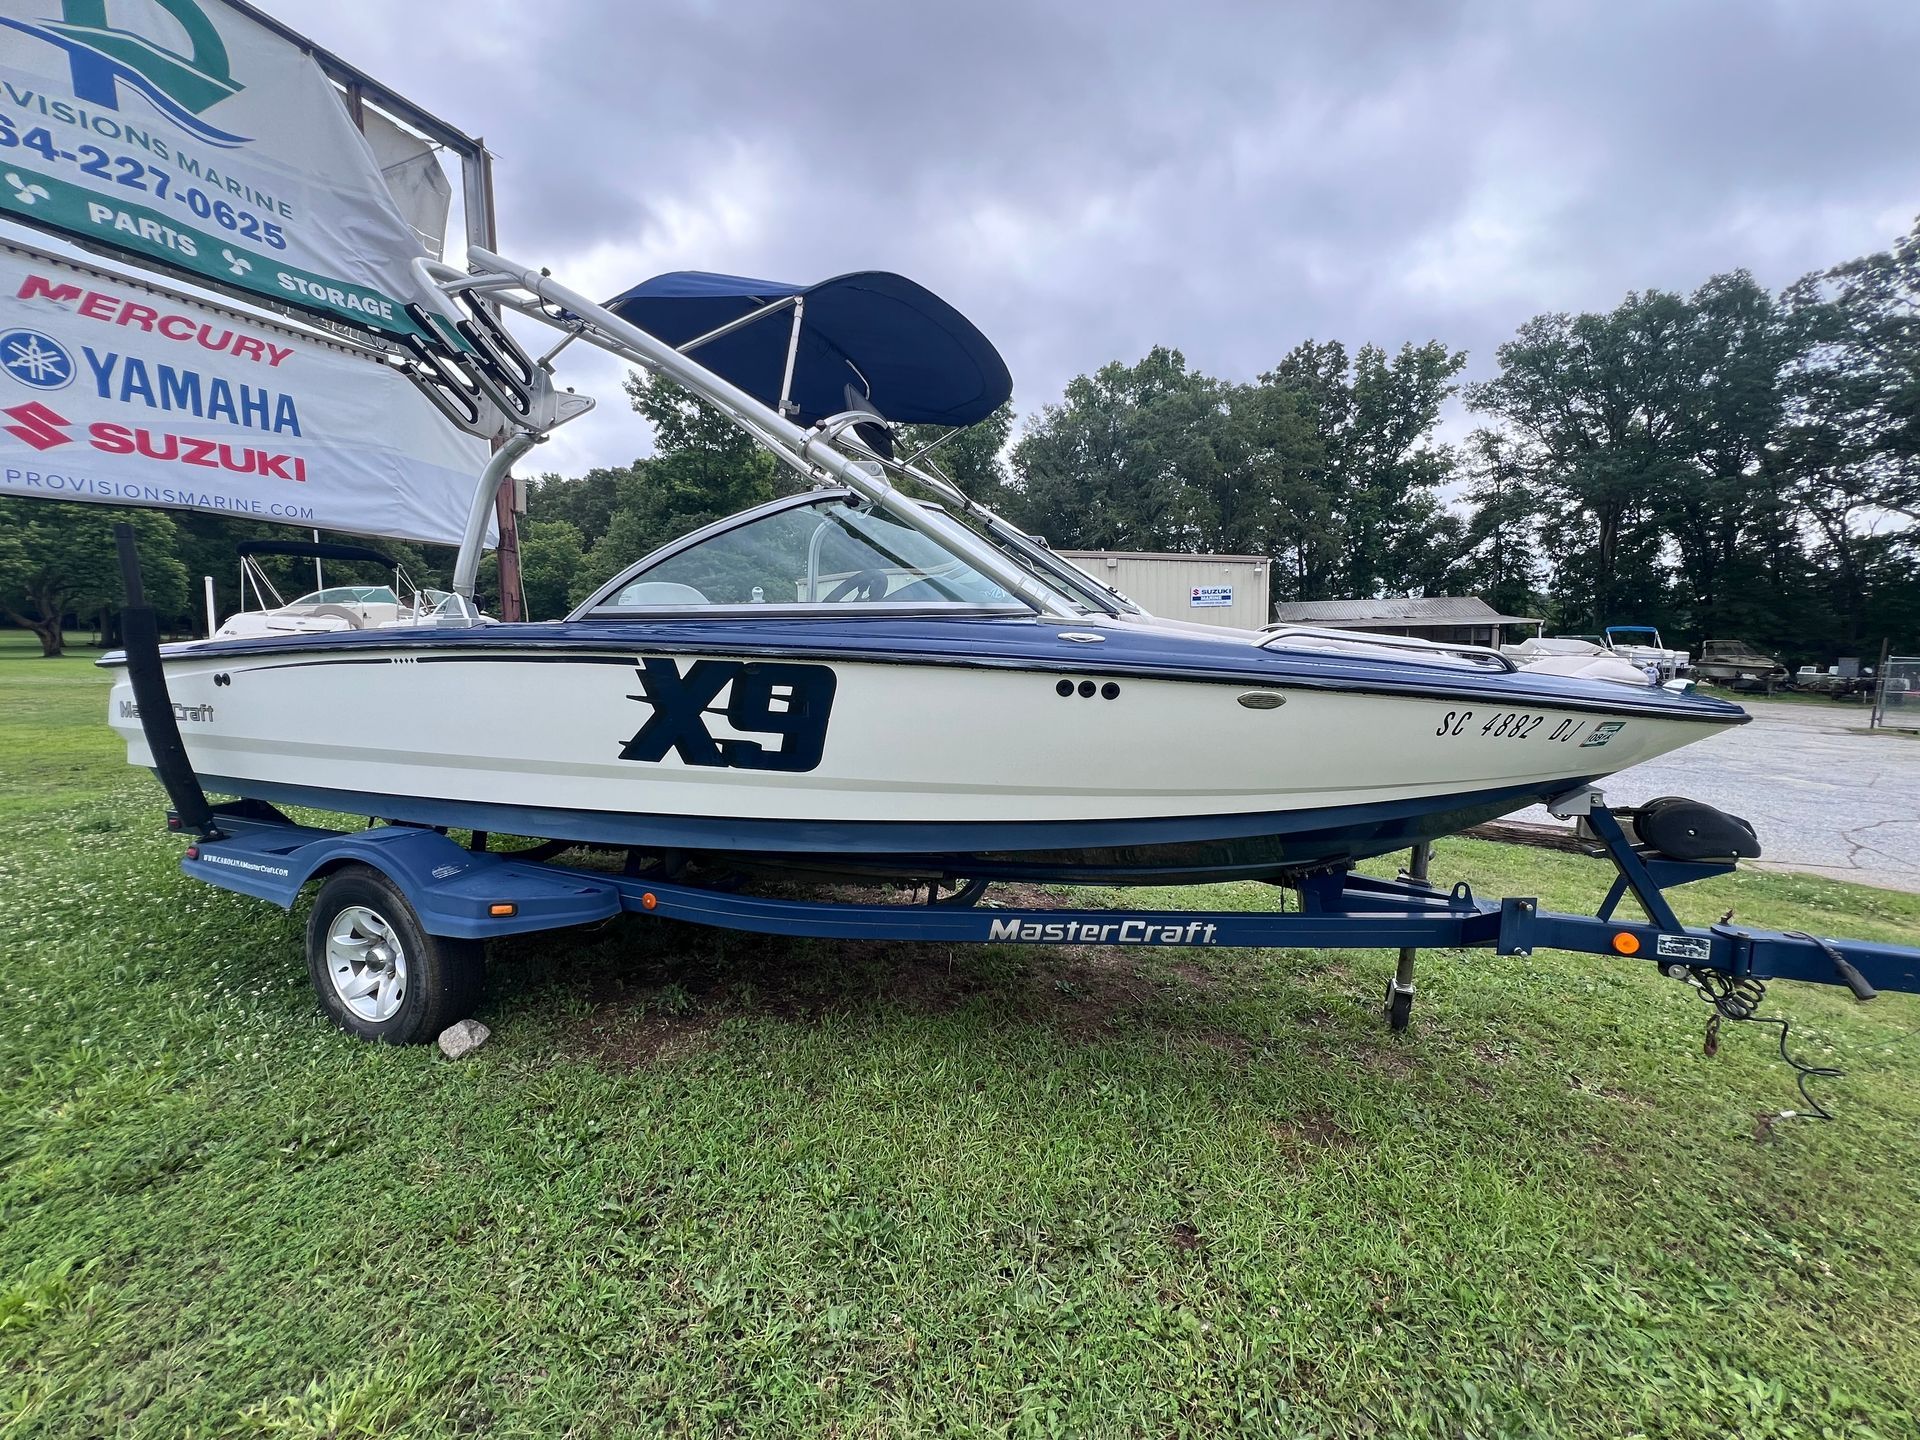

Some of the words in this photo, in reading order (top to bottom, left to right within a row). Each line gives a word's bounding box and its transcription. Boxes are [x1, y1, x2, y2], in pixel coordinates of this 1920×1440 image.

[0, 80, 169, 161] VISIONS
[178, 150, 294, 220] MARINE
[88, 201, 198, 257] PARTS
[277, 272, 393, 321] STORAGE
[16, 274, 295, 368] MERCURY
[81, 346, 303, 437] YAMAHA
[6, 469, 314, 520] PROVISIONSMARINE.COM
[88, 422, 307, 482] SUZUKI
[618, 657, 837, 772] X9
[1436, 711, 1473, 736] SC
[1481, 713, 1544, 739] 4882
[1548, 719, 1586, 742] DJ
[988, 919, 1217, 944] MasterCraft
